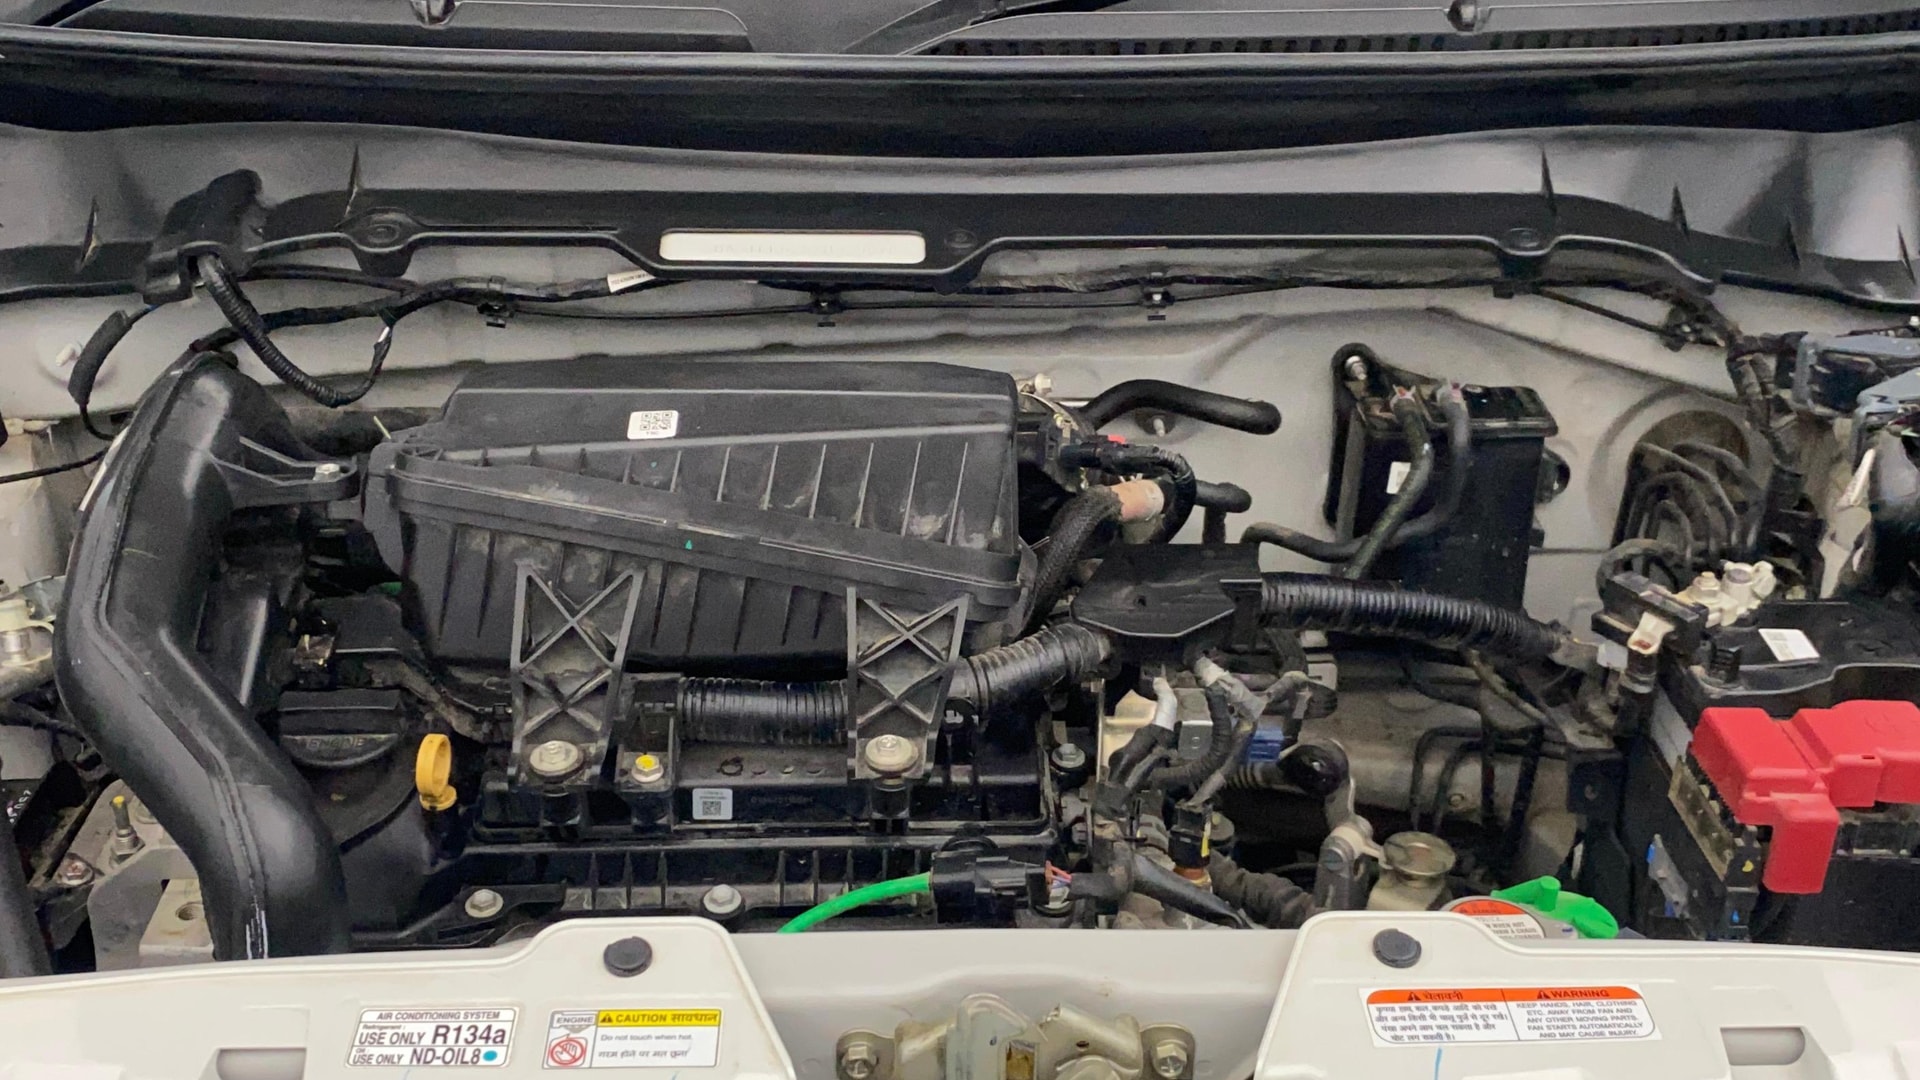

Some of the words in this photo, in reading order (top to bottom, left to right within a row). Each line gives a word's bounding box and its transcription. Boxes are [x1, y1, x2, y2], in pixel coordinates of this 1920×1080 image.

[1550, 990, 1610, 998] WARNING
[377, 1012, 392, 1020] AIR
[395, 1011, 460, 1020] CONDITIONING
[463, 1011, 500, 1019] SYSTEM
[556, 1016, 594, 1024] ENGINE
[616, 1013, 667, 1023] CAUTION
[671, 1013, 718, 1023] सावधान
[1579, 1022, 1643, 1030] AUTOMATICALLY
[359, 1032, 386, 1045] USE
[389, 1032, 426, 1045] ONLY
[432, 1024, 507, 1044] R134a
[353, 1054, 374, 1064] USE
[375, 1054, 404, 1064] ONLY
[410, 1047, 482, 1064] ND-OIL8
